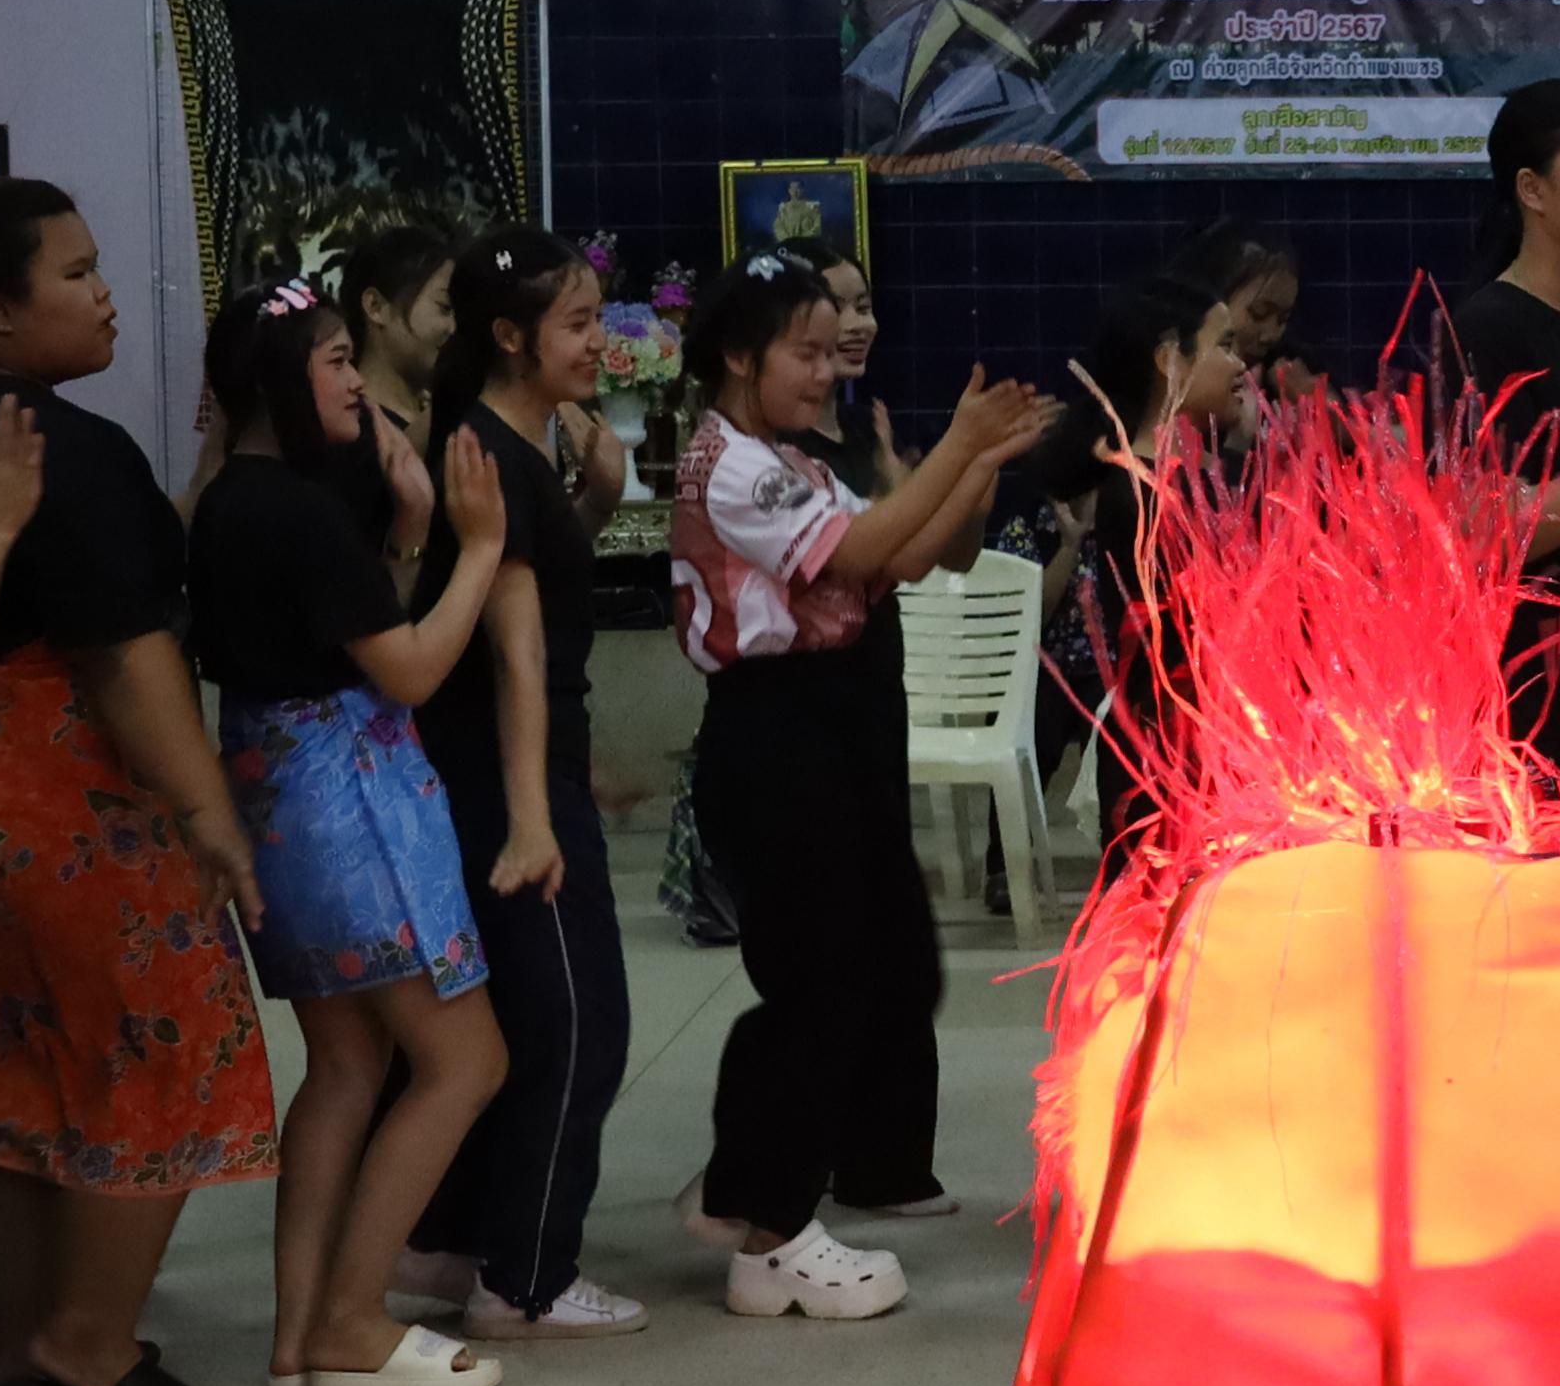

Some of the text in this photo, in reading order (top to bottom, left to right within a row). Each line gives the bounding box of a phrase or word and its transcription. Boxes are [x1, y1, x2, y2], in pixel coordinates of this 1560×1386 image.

[1226, 11, 1386, 41] ประจำปี 2567
[1170, 53, 1444, 84] ณ ค่ายลูกเสือจังหวัดกำแพงเพชร
[1243, 103, 1367, 133] ลูกเสือสามัญ
